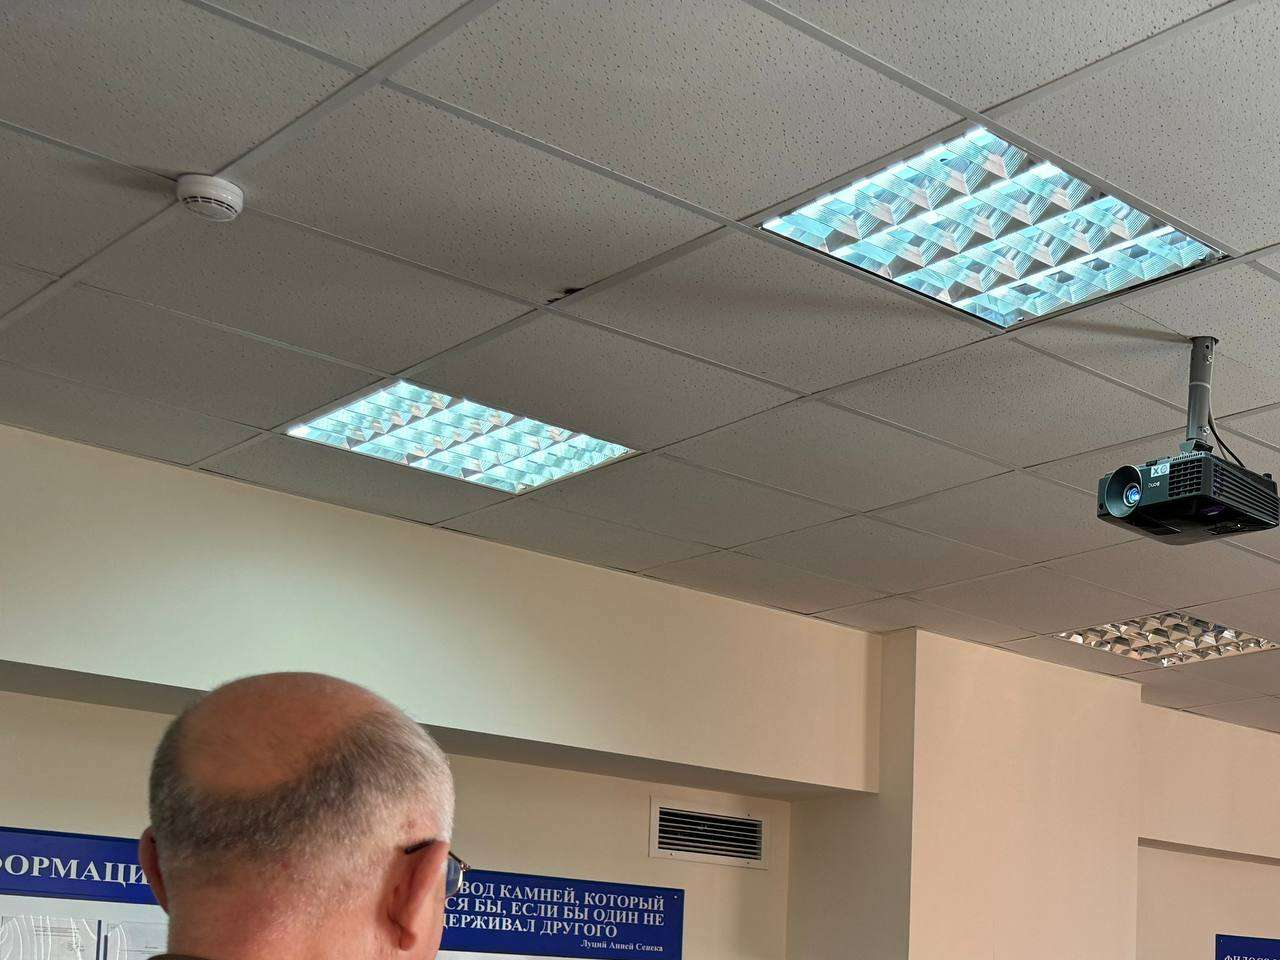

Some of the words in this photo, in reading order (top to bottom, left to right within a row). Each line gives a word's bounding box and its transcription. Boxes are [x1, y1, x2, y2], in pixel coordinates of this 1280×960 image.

[0, 854, 150, 888] ОРМАЦИ
[444, 896, 470, 912] СЯ
[474, 898, 507, 916] БЫ,
[511, 901, 559, 918] ЕСЛИ
[563, 906, 590, 921] БЫ
[593, 908, 639, 925] ОДИН
[643, 912, 665, 926] НЕ
[460, 881, 496, 900] ВОД
[499, 883, 580, 906] КАМНЕЙ,
[583, 892, 665, 911] КОТОРЫЙ
[442, 912, 536, 933] ЕРЖИВАЛ
[539, 920, 618, 938] ДРУГОГО
[580, 939, 607, 950] Луций
